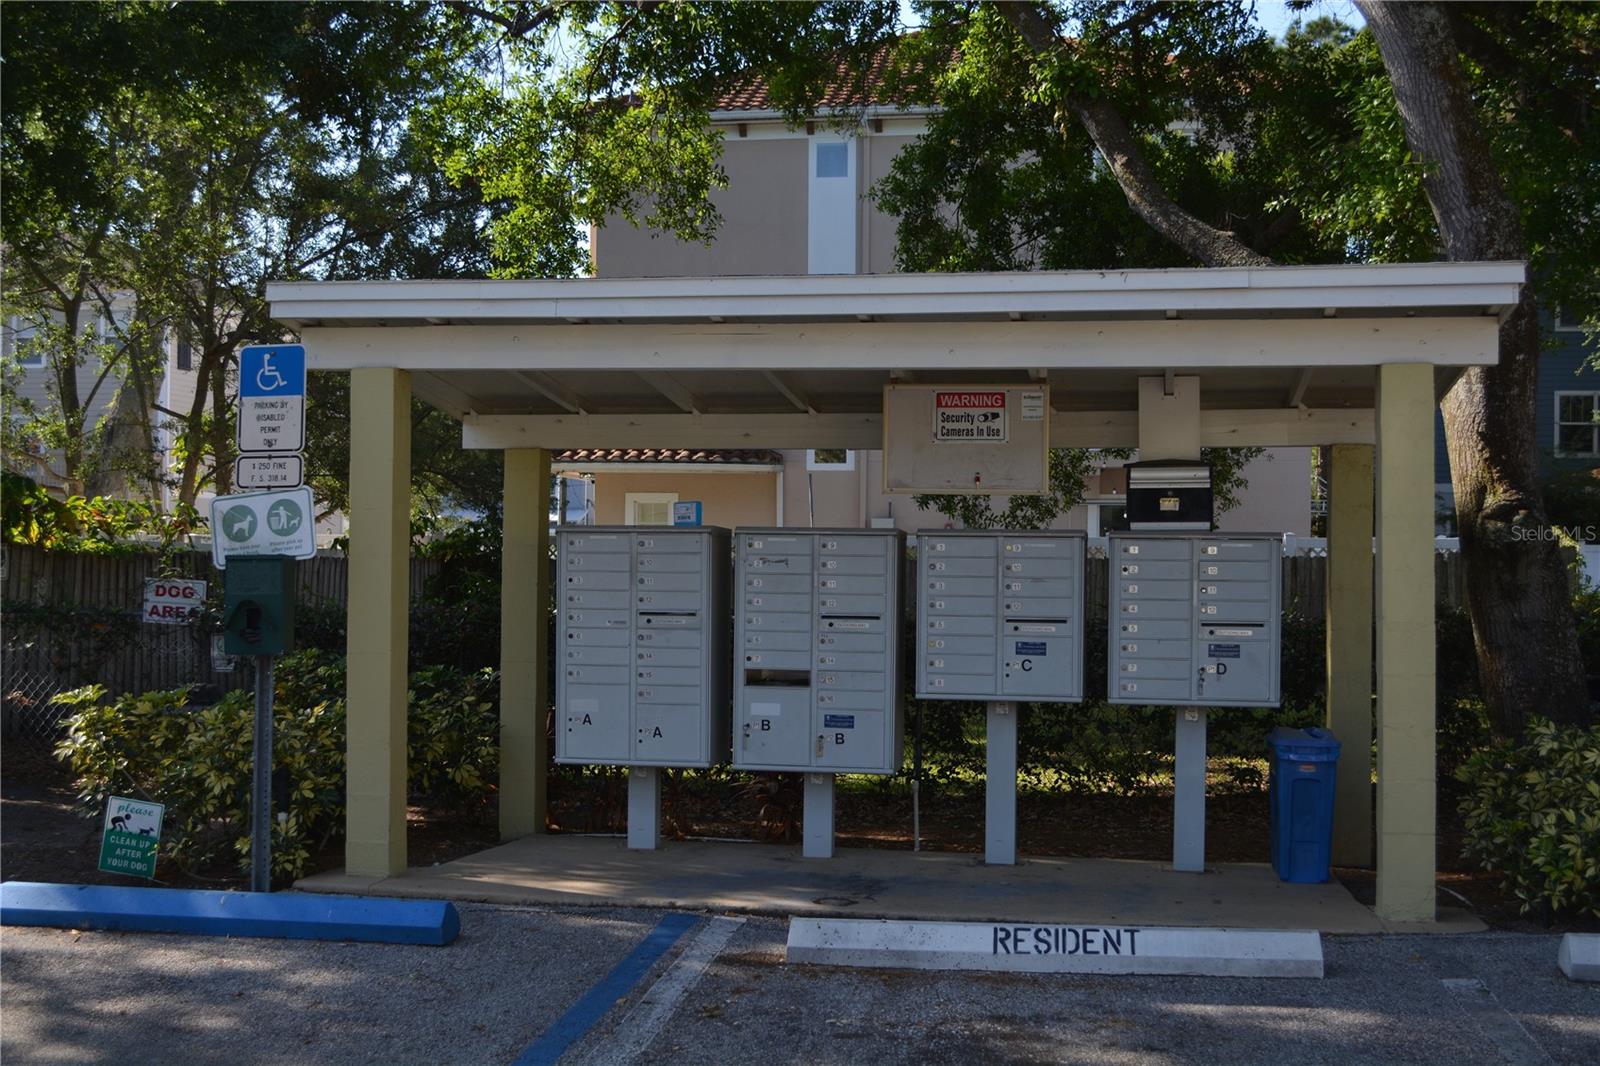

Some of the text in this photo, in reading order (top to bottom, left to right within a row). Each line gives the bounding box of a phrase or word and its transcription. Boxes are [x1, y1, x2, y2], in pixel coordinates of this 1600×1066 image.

[940, 395, 1002, 407] WARNING
[256, 413, 286, 422] DISABLED
[940, 412, 975, 425] Security
[260, 426, 281, 434] PERMIT
[940, 426, 1001, 437] Cameras In Use
[155, 584, 194, 598] DOG
[1021, 658, 1033, 672] C
[1216, 662, 1227, 675] D
[582, 713, 592, 725] A
[761, 719, 771, 731] B
[652, 726, 663, 738] A
[835, 733, 845, 744] B
[117, 803, 154, 816] please
[110, 835, 151, 849] CLEAN UP
[115, 848, 142, 859] AFTER
[107, 857, 148, 871] YOUR DOG
[993, 926, 1140, 955] RESIDENT
